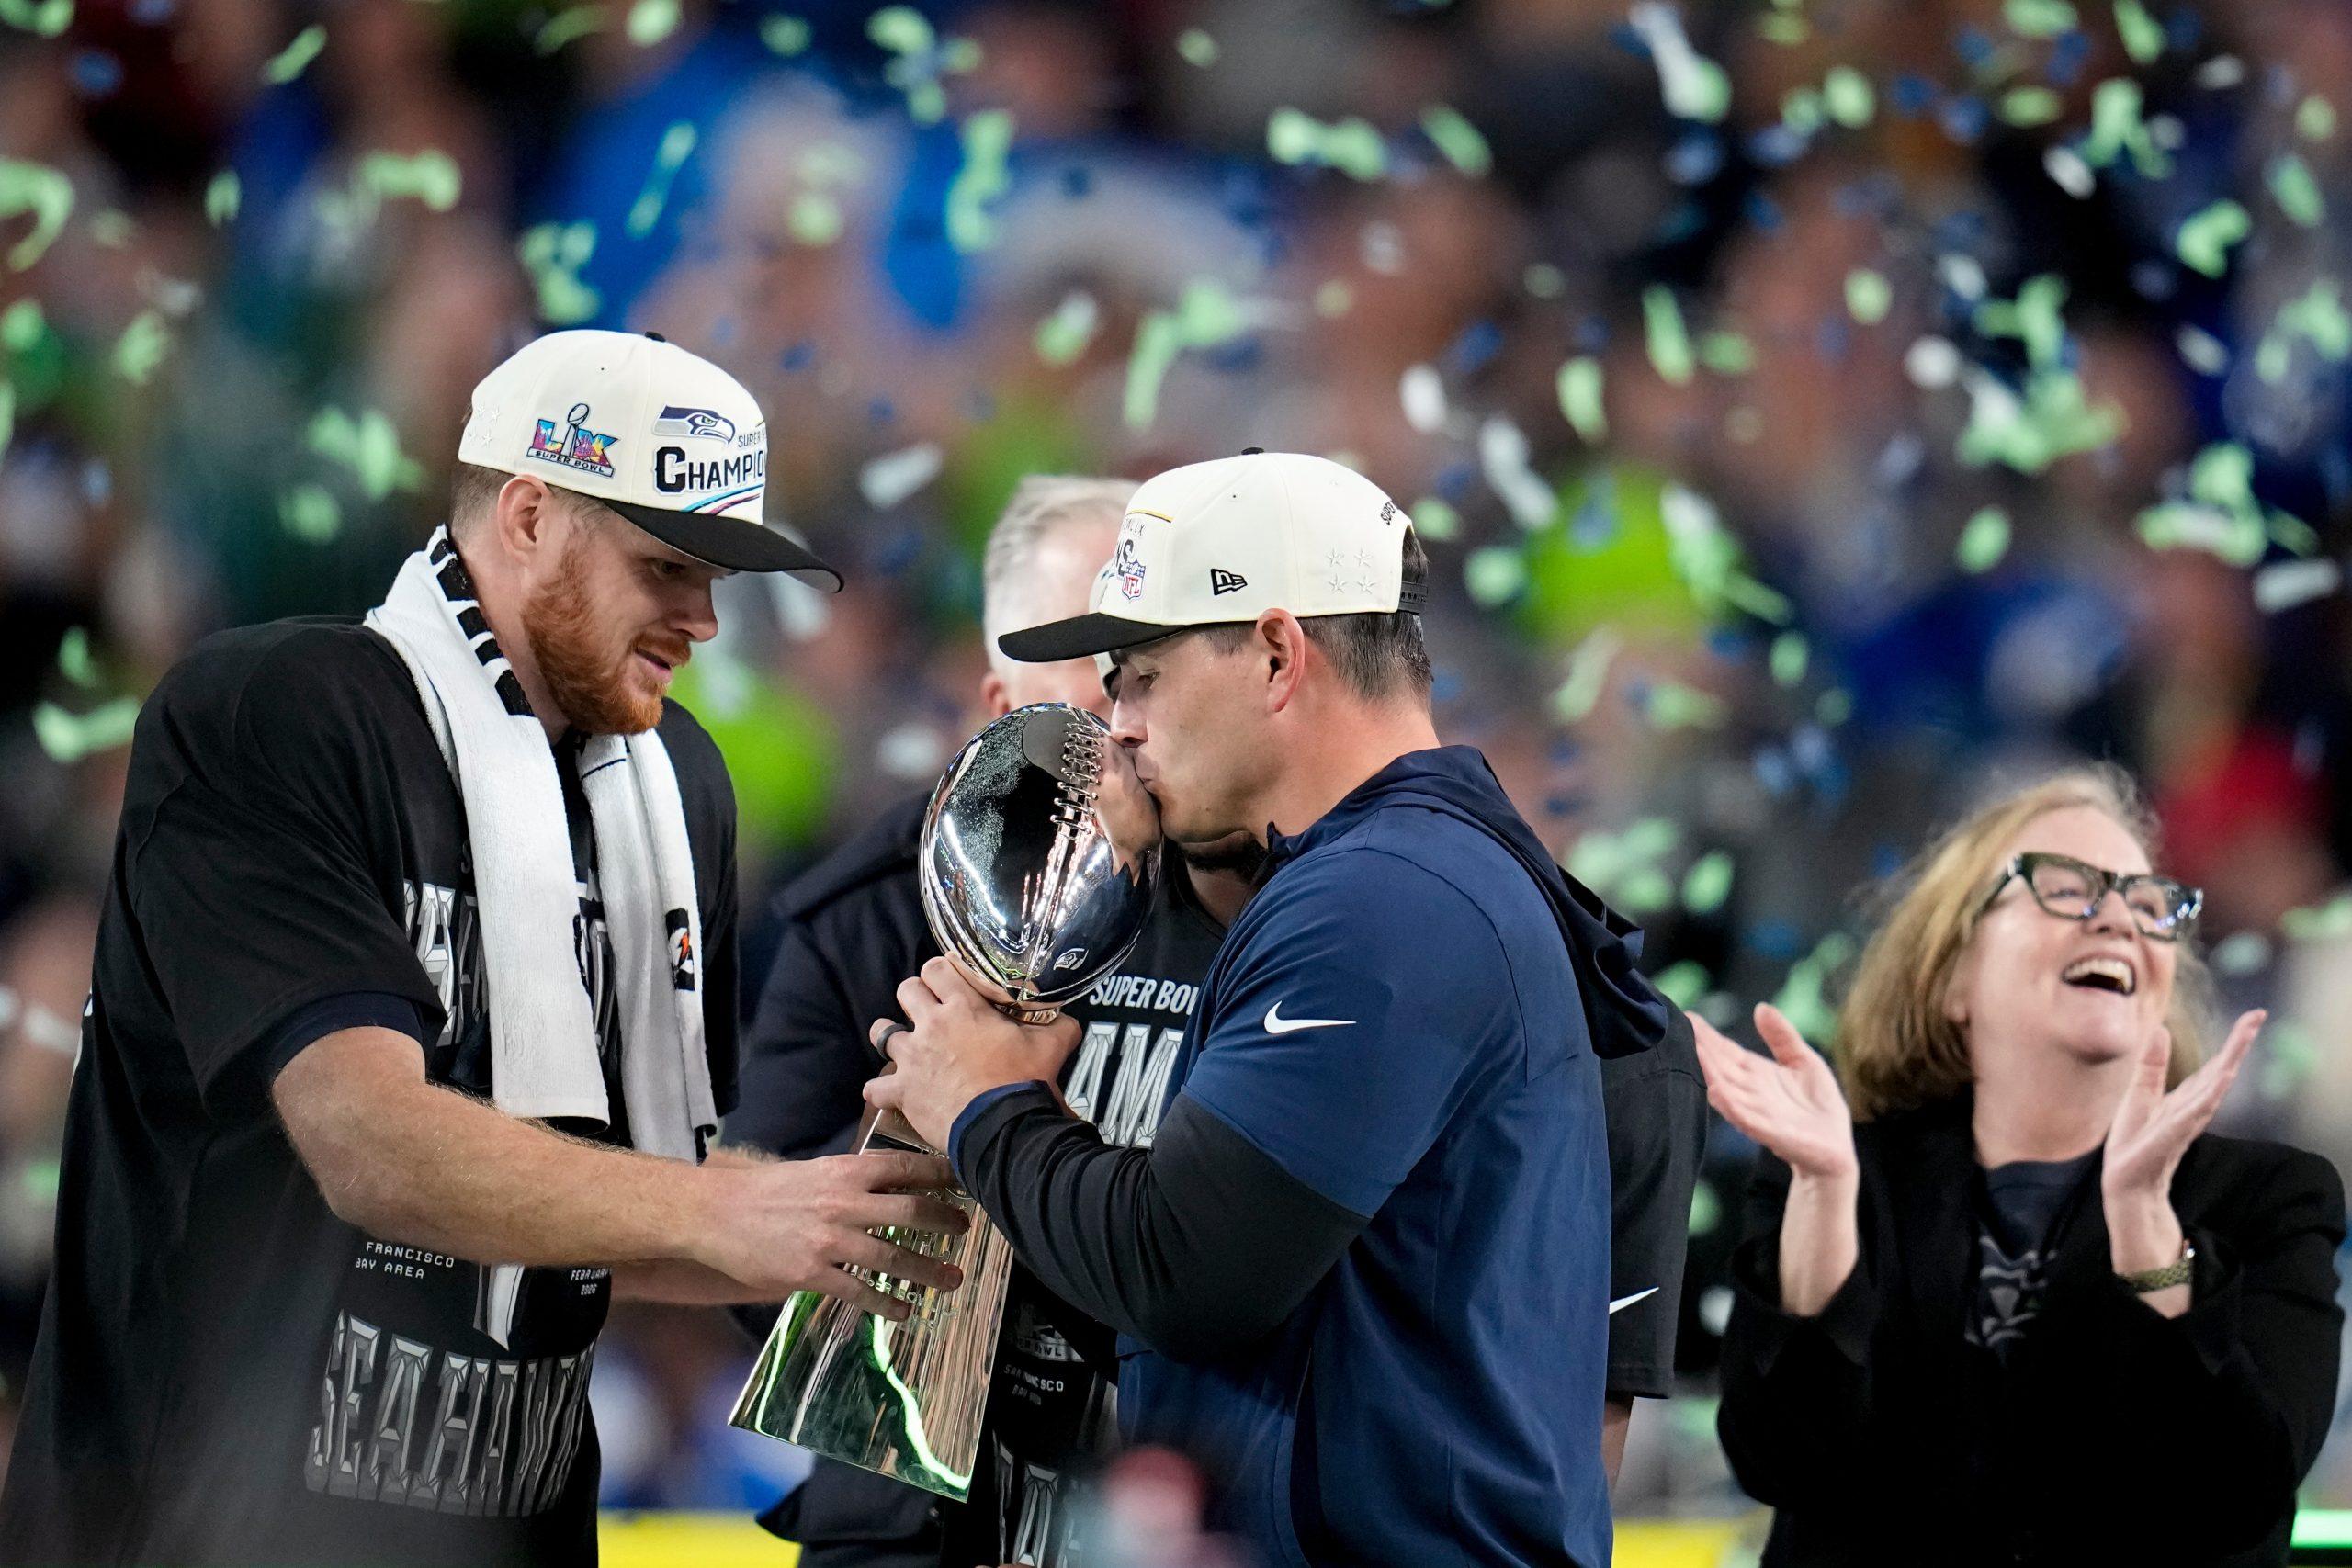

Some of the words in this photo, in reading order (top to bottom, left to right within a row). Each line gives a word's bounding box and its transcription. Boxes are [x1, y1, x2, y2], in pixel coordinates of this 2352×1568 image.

[535, 450, 571, 463] SUPER
[574, 459, 605, 473] BOWL
[1090, 976, 1157, 1009] SUPER
[367, 1241, 455, 1268] FRANCISCO
[384, 1262, 424, 1280] AREA
